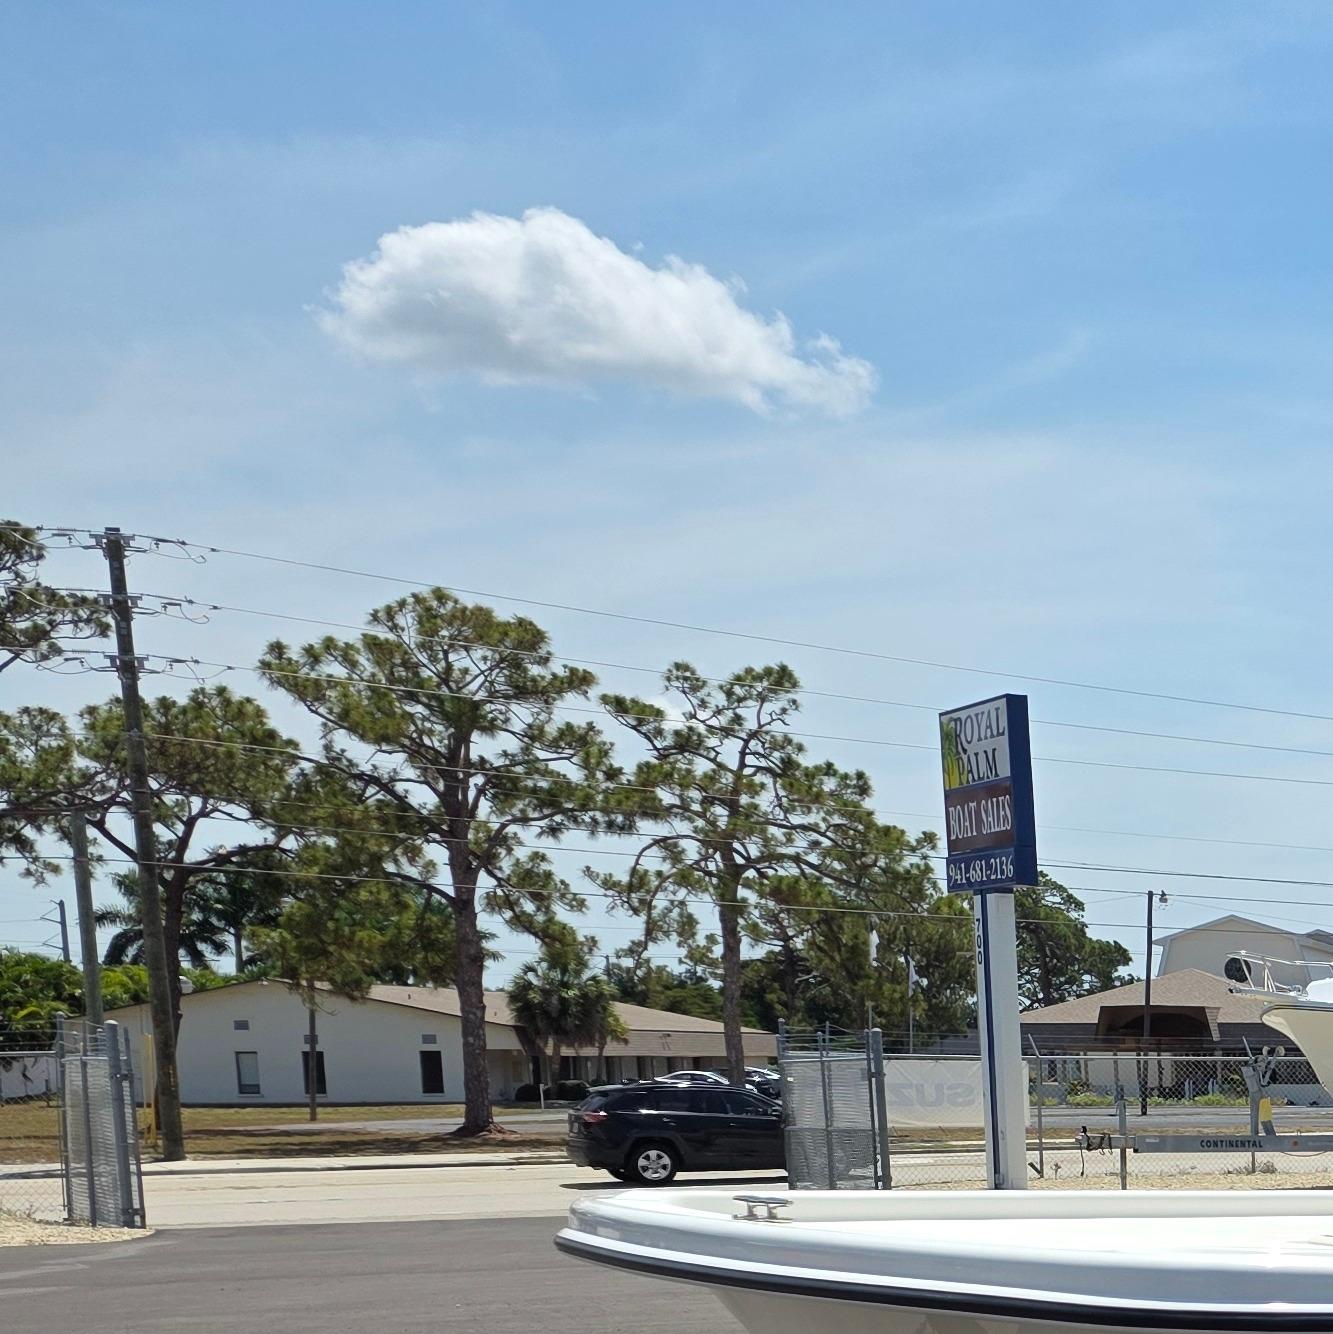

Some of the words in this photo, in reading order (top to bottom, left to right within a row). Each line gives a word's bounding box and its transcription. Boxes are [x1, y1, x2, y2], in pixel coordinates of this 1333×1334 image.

[953, 707, 1006, 756] ROYAL
[957, 748, 1000, 787] PALM
[948, 802, 977, 840] BOAT
[981, 794, 1012, 835] SALES
[949, 855, 1014, 887] 941-681-2136
[1200, 1139, 1263, 1149] CONTINENTAL
